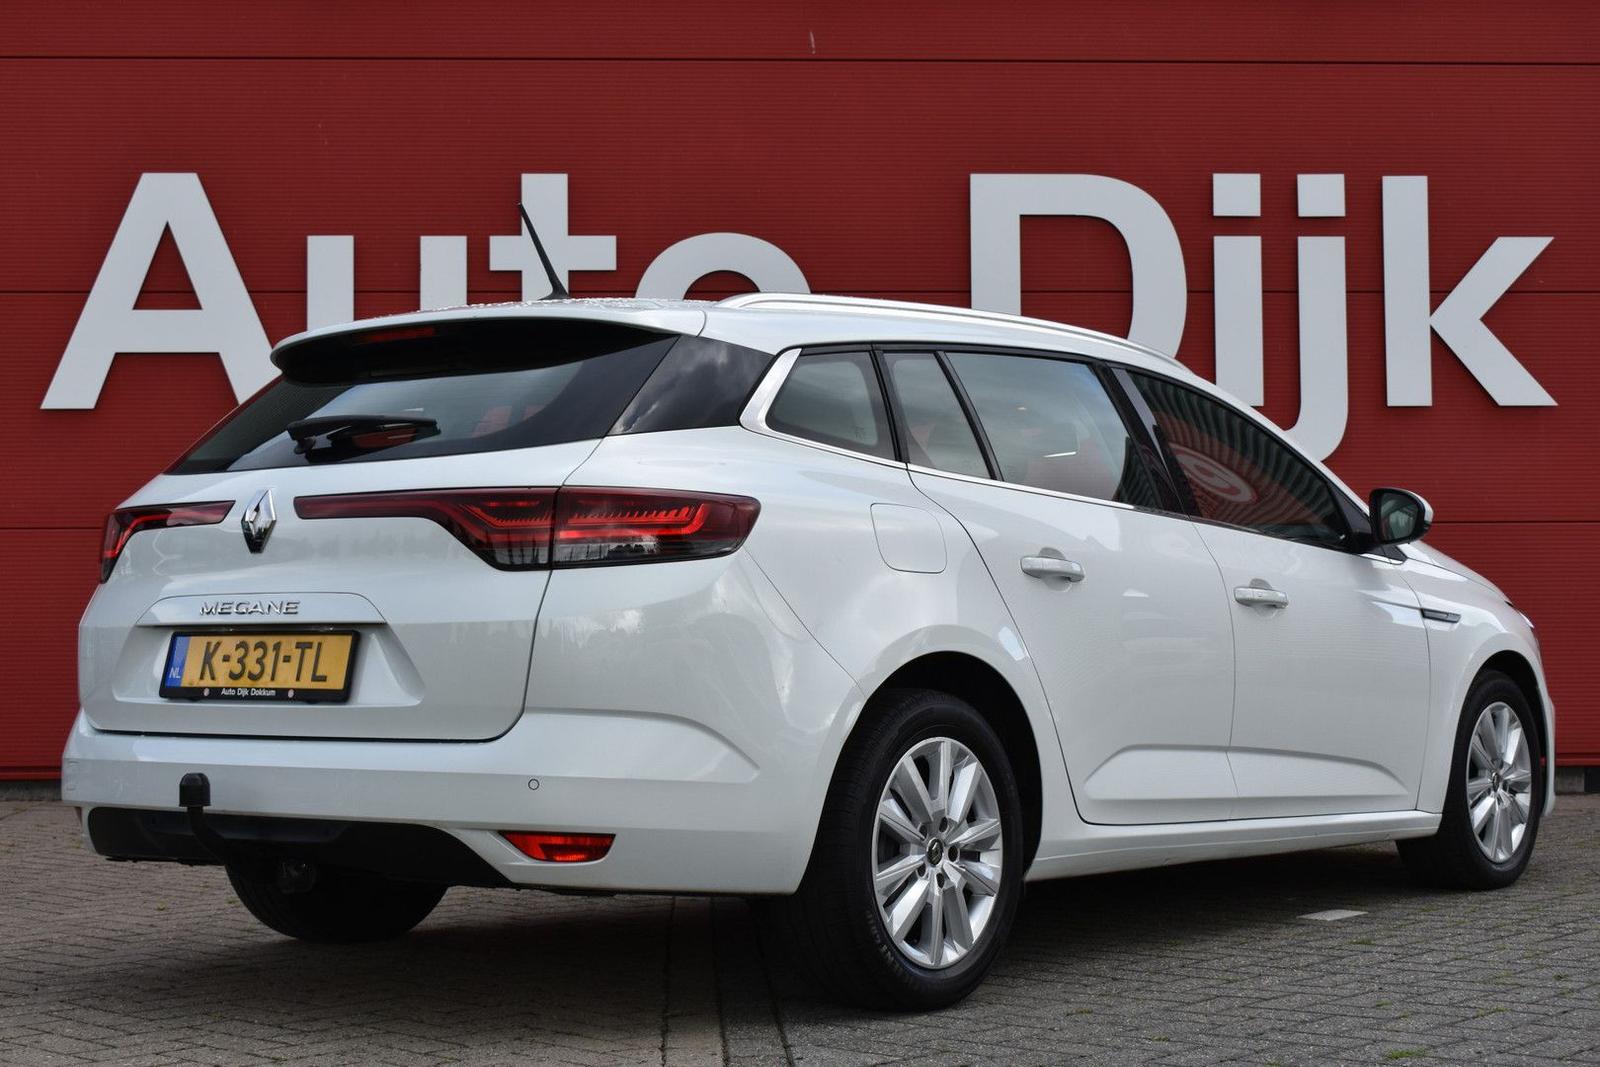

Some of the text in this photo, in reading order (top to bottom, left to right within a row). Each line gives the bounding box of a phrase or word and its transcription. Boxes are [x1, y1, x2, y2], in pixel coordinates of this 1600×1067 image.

[969, 173, 1558, 463] Dijk
[200, 600, 300, 615] MEGANE
[200, 640, 328, 682] K-331-TL
[169, 667, 181, 679] NL
[221, 687, 276, 698] Auto Dijk Dokkum
